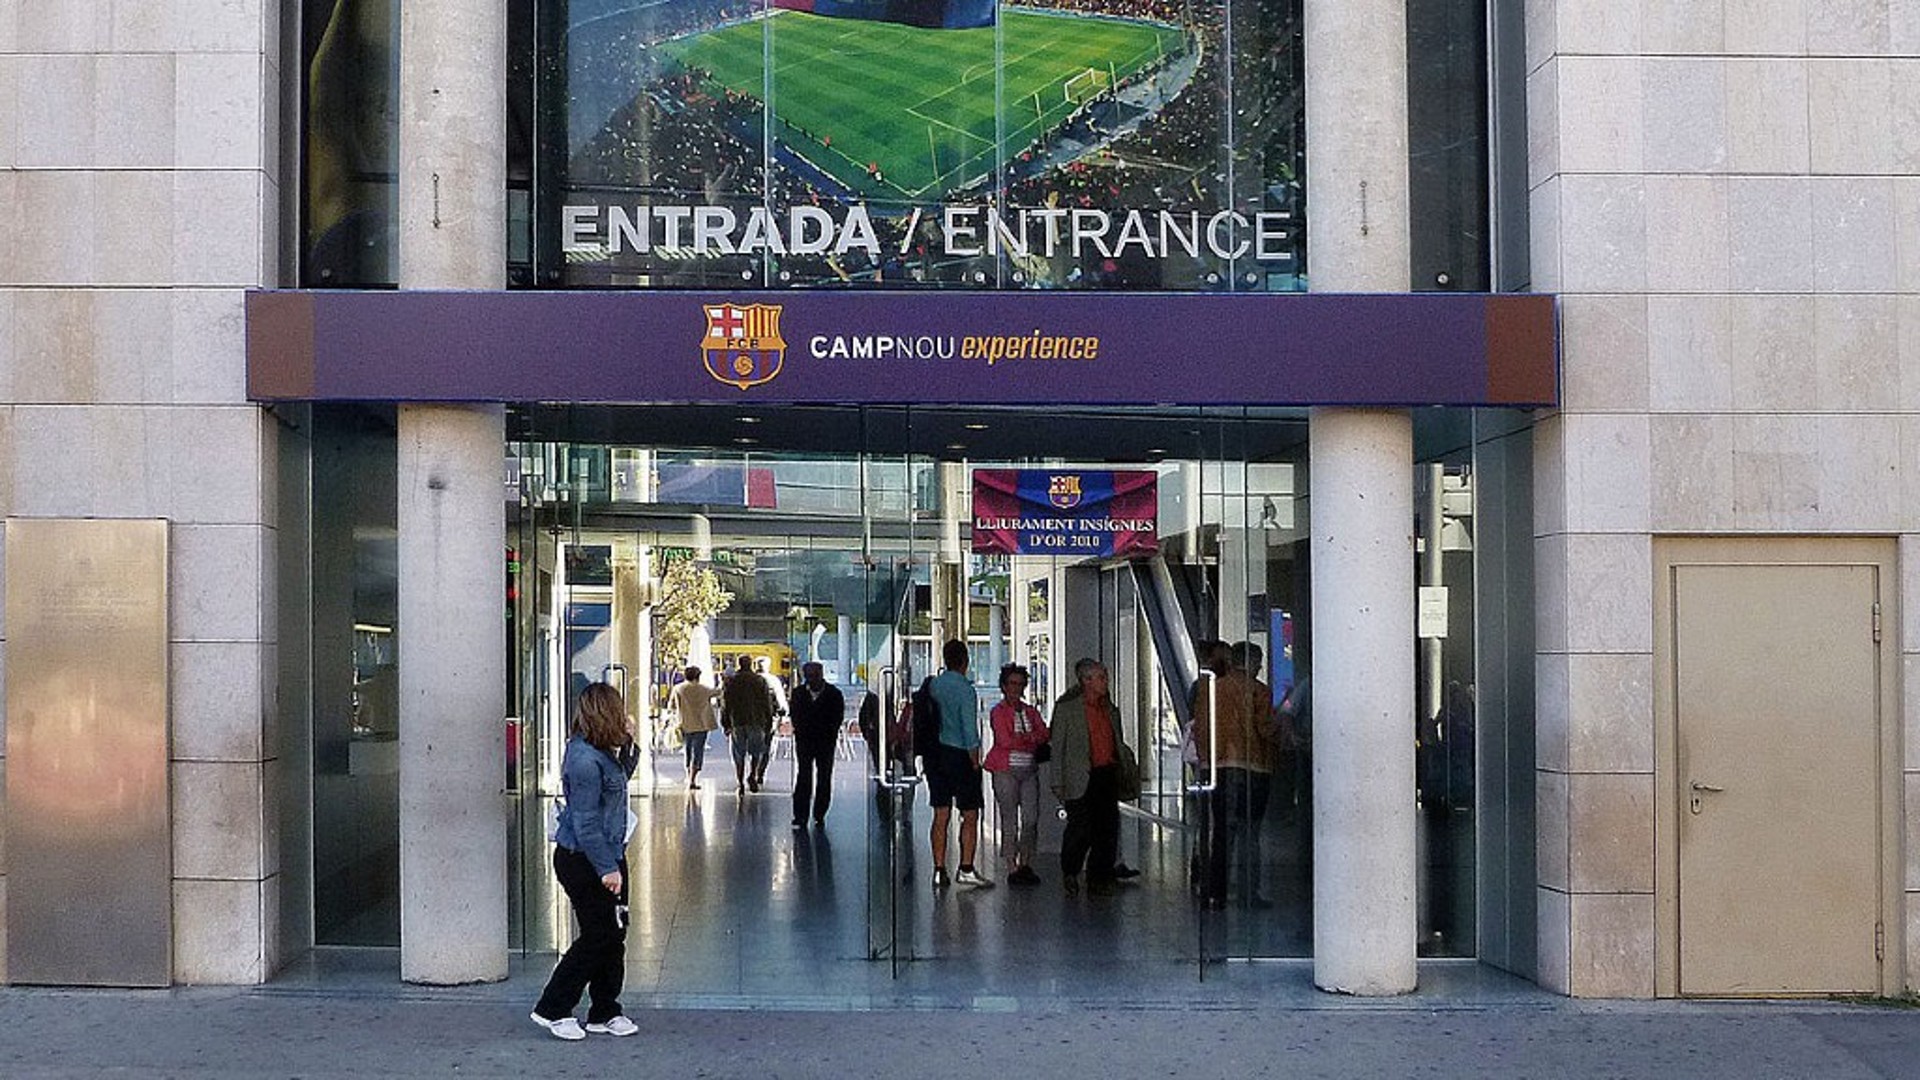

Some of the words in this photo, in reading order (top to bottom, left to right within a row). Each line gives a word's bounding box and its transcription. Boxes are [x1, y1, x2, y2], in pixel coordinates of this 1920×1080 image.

[561, 205, 882, 255] ENTRADA
[943, 206, 1292, 260] ENTRANCE
[960, 329, 1100, 365] experience
[976, 516, 1076, 531] LLIURAMENT
[1079, 515, 1155, 532] INSÍGNIES
[1029, 534, 1067, 547] D'OR
[1070, 535, 1101, 547] 2010
